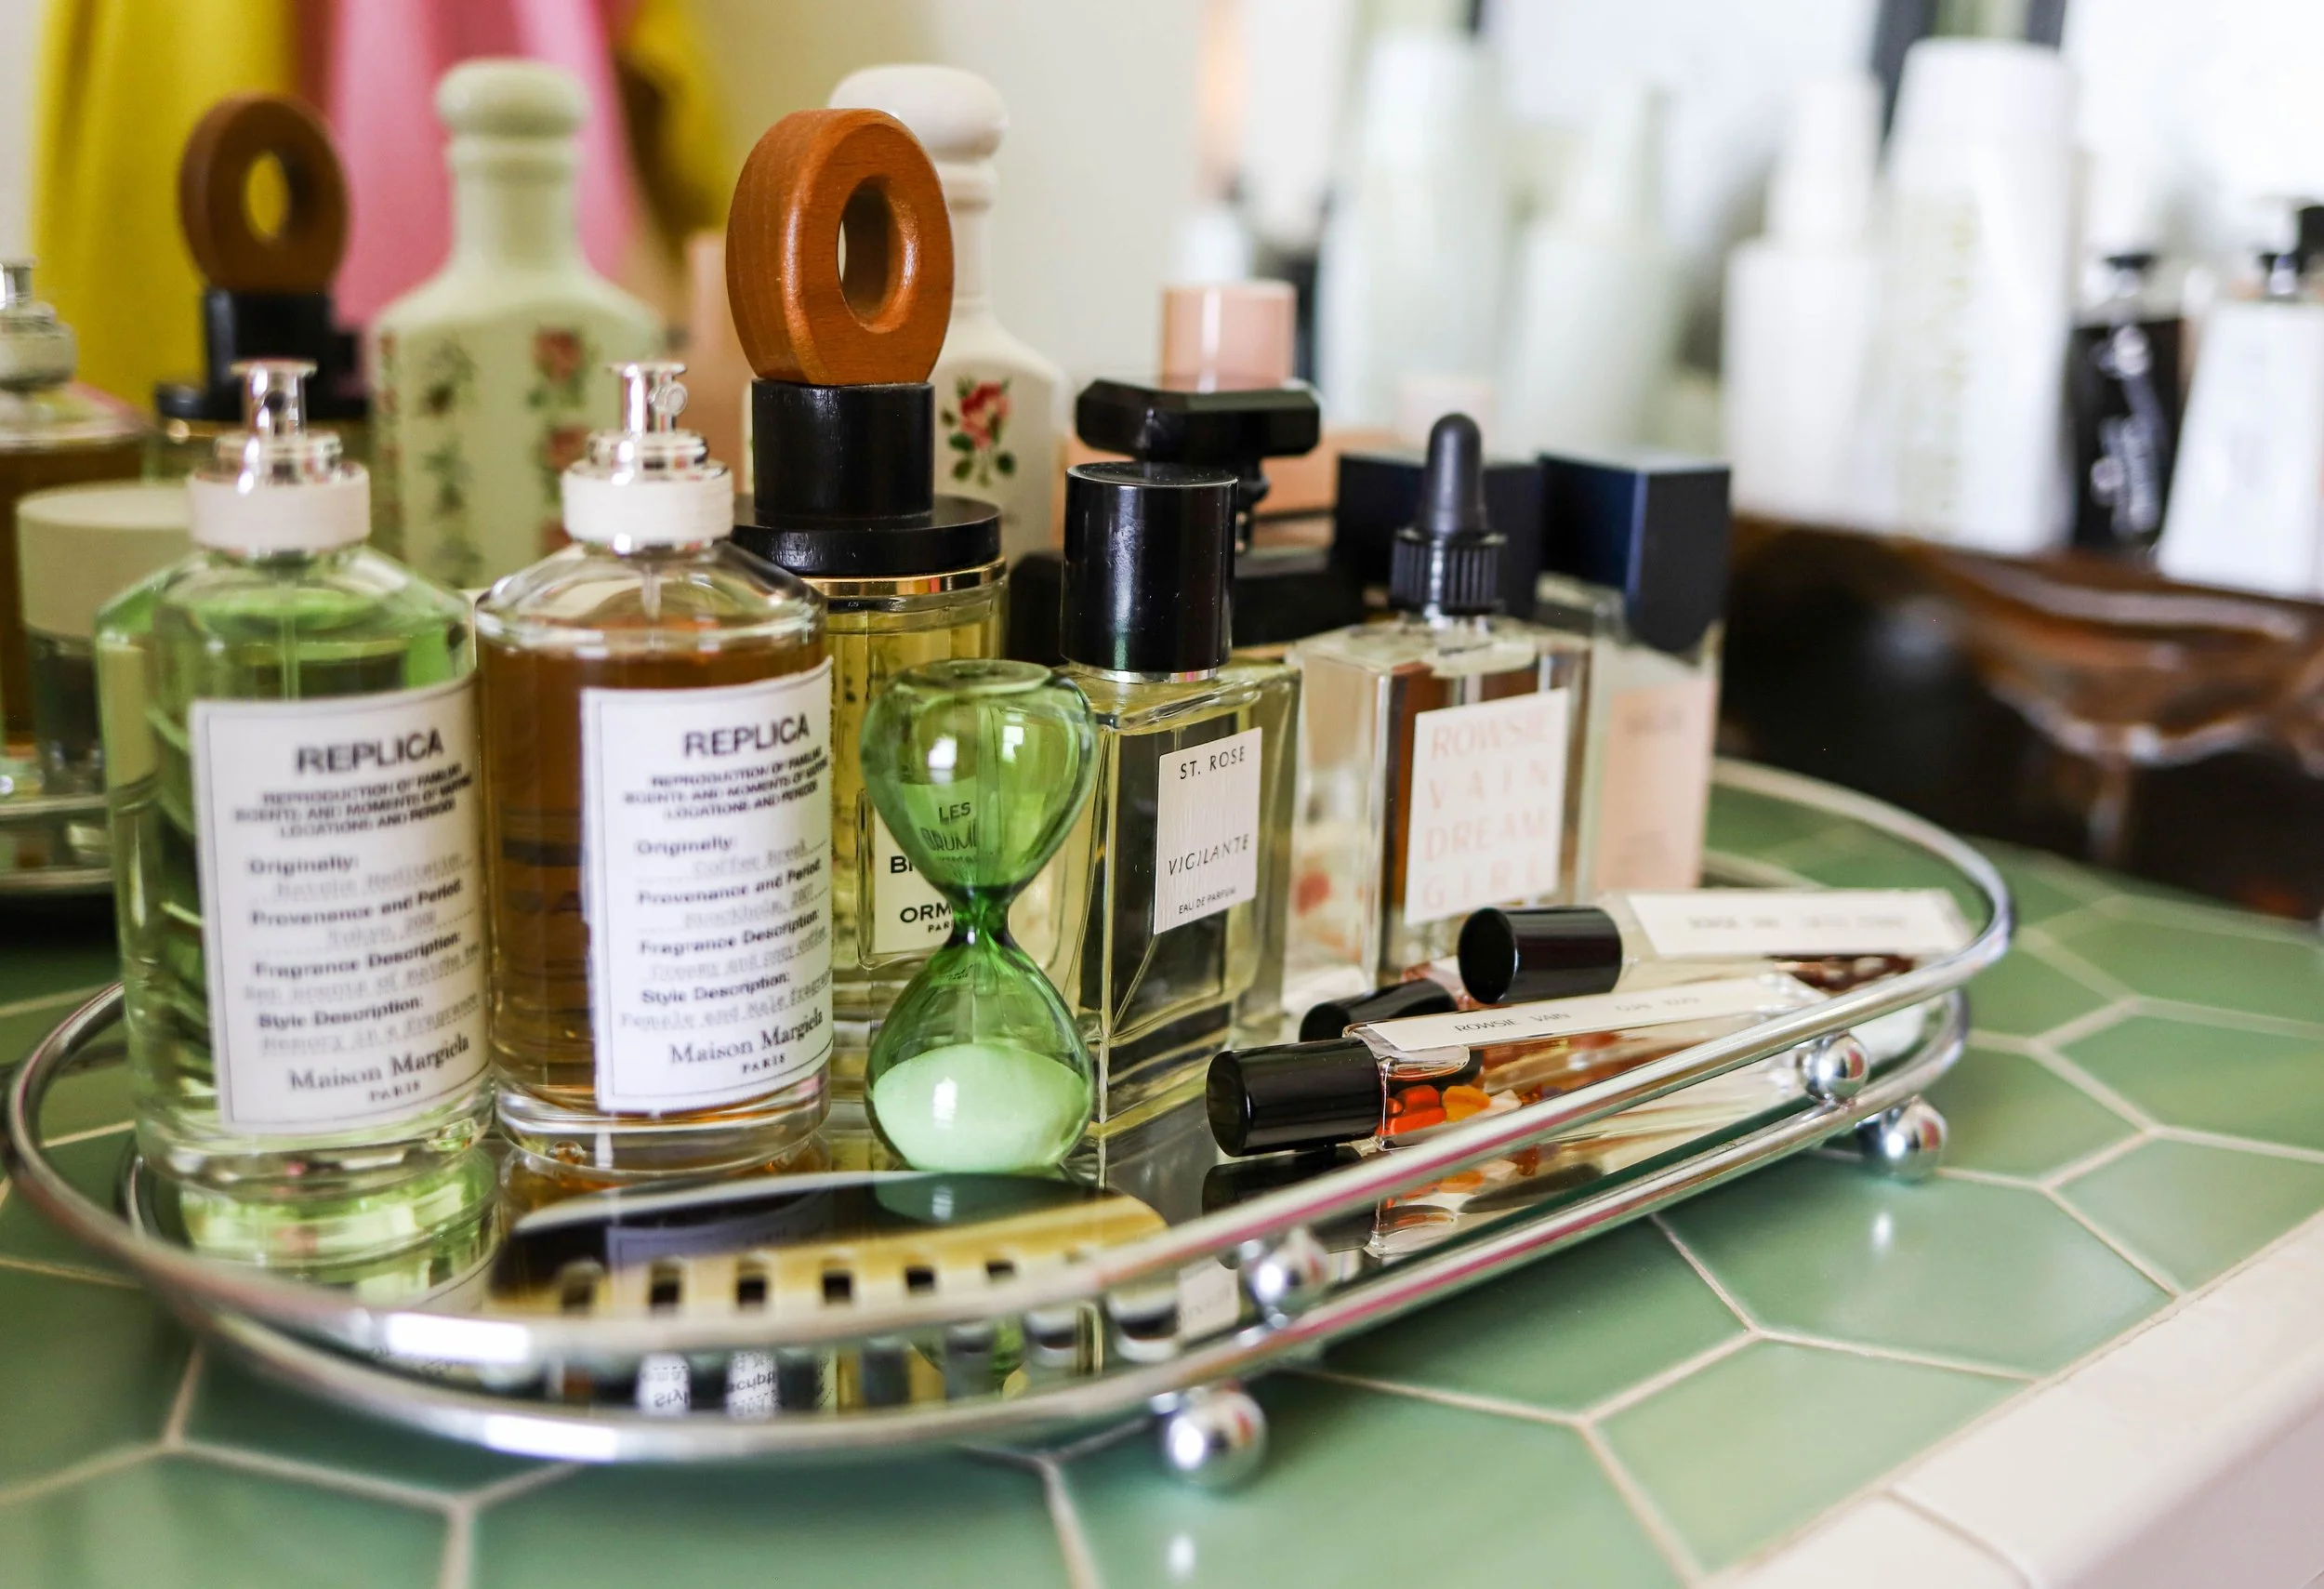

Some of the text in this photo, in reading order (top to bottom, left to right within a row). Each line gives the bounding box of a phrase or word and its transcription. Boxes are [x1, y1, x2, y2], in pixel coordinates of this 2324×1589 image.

[683, 712, 811, 758] REPLICA
[296, 728, 444, 775] REPLICA
[1180, 746, 1246, 780] ST. ROSE
[938, 801, 971, 824] LES
[920, 818, 977, 852] BRUM
[1169, 833, 1249, 877] VIGILANTE
[638, 884, 748, 906] Provenance
[755, 873, 784, 893] and
[252, 906, 374, 926] Provenance
[381, 896, 413, 915] and
[900, 902, 951, 923] ORM
[1179, 902, 1195, 915] EAU
[1196, 896, 1206, 908] DE
[928, 921, 953, 933] PAR
[640, 936, 737, 957] Fragrance
[255, 959, 361, 979] Fragrance
[641, 971, 790, 1007] Style Description:
[258, 996, 424, 1030] Style Description:
[1455, 1012, 1571, 1033] ROWSIE VAIN
[669, 1007, 824, 1064] Maison Margiela
[289, 1032, 469, 1090] Maison Margiela
[742, 1054, 786, 1074] PARIS
[370, 1079, 421, 1102] PARIS
